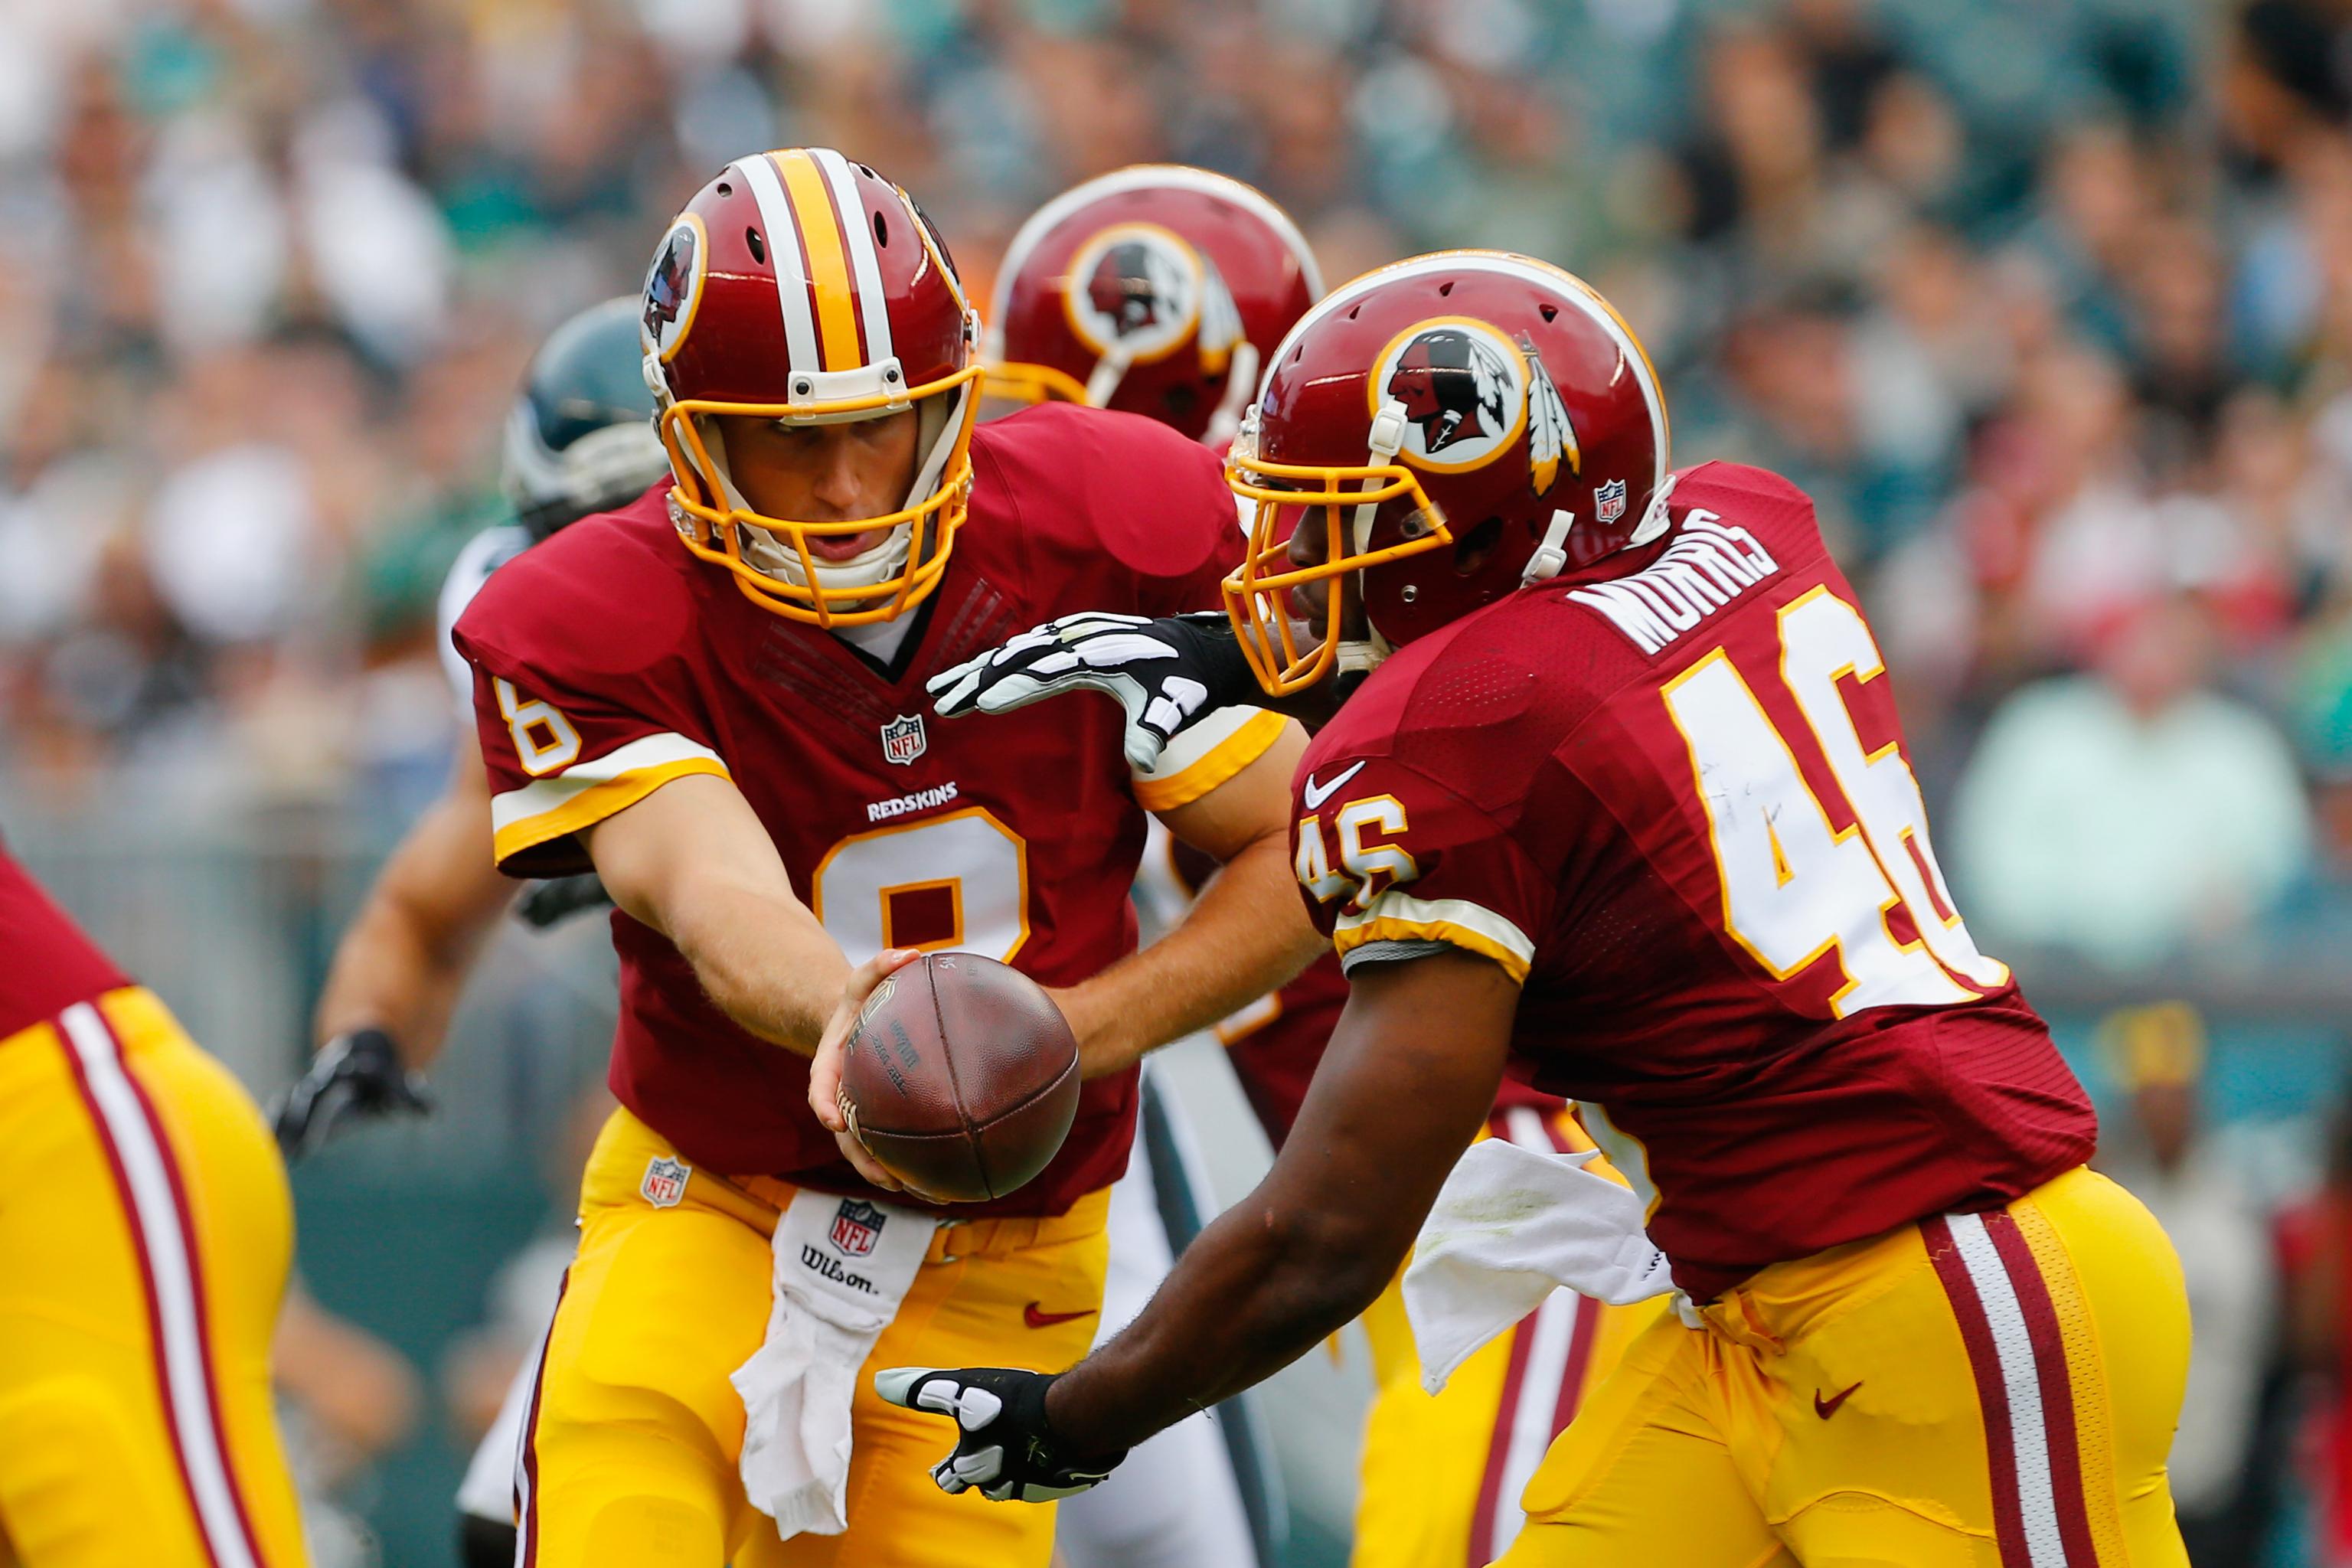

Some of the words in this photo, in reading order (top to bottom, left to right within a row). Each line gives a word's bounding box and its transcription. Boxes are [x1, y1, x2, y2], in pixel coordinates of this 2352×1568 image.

[1565, 508, 1779, 656] MORRIS
[890, 736, 921, 756] NFL
[867, 781, 958, 822] REDSKINS
[1660, 583, 2010, 1021] 46
[1296, 793, 1419, 910] 46
[647, 1175, 675, 1201] NFL
[833, 1217, 870, 1252] NFL
[802, 1243, 873, 1294] Wilson
